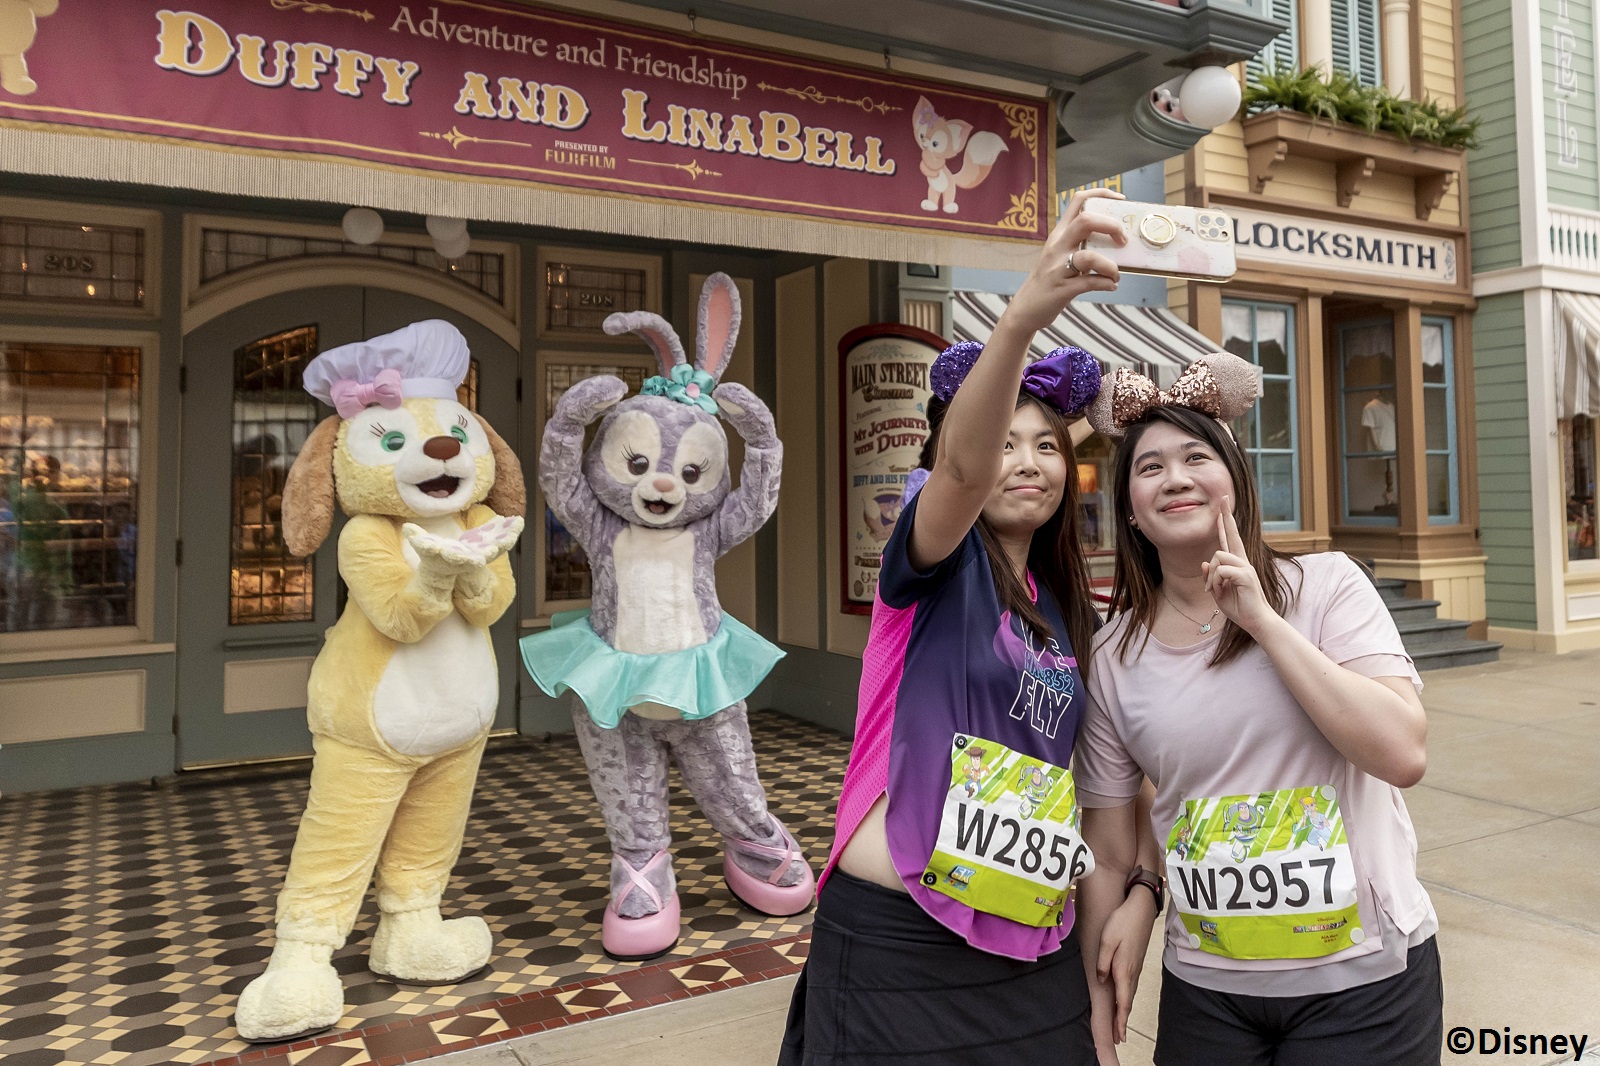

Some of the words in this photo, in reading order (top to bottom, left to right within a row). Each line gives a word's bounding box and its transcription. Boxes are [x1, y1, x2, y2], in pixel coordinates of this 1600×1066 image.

[388, 5, 548, 59] Adventure
[555, 39, 607, 68] and
[614, 44, 748, 99] Friendship
[154, 9, 420, 105] DUFFY
[454, 71, 591, 131] AND
[554, 139, 598, 152] PRESENTED
[598, 145, 609, 154] BY
[545, 148, 616, 170] FUJIFILM
[1231, 217, 1437, 270] LOCKSMITH
[44, 254, 94, 272] 208
[580, 292, 614, 306] 208
[851, 363, 877, 394] MAIN
[879, 362, 928, 391] STREET
[861, 384, 915, 402] Cinema
[868, 417, 927, 438] JOURNEYS
[854, 441, 874, 456] WITH
[876, 432, 927, 454] DUFFY
[869, 474, 884, 485] AND
[885, 474, 898, 484] HIS
[1009, 670, 1073, 740] FLY
[956, 802, 1088, 884] W2856
[1176, 857, 1336, 911] W2957
